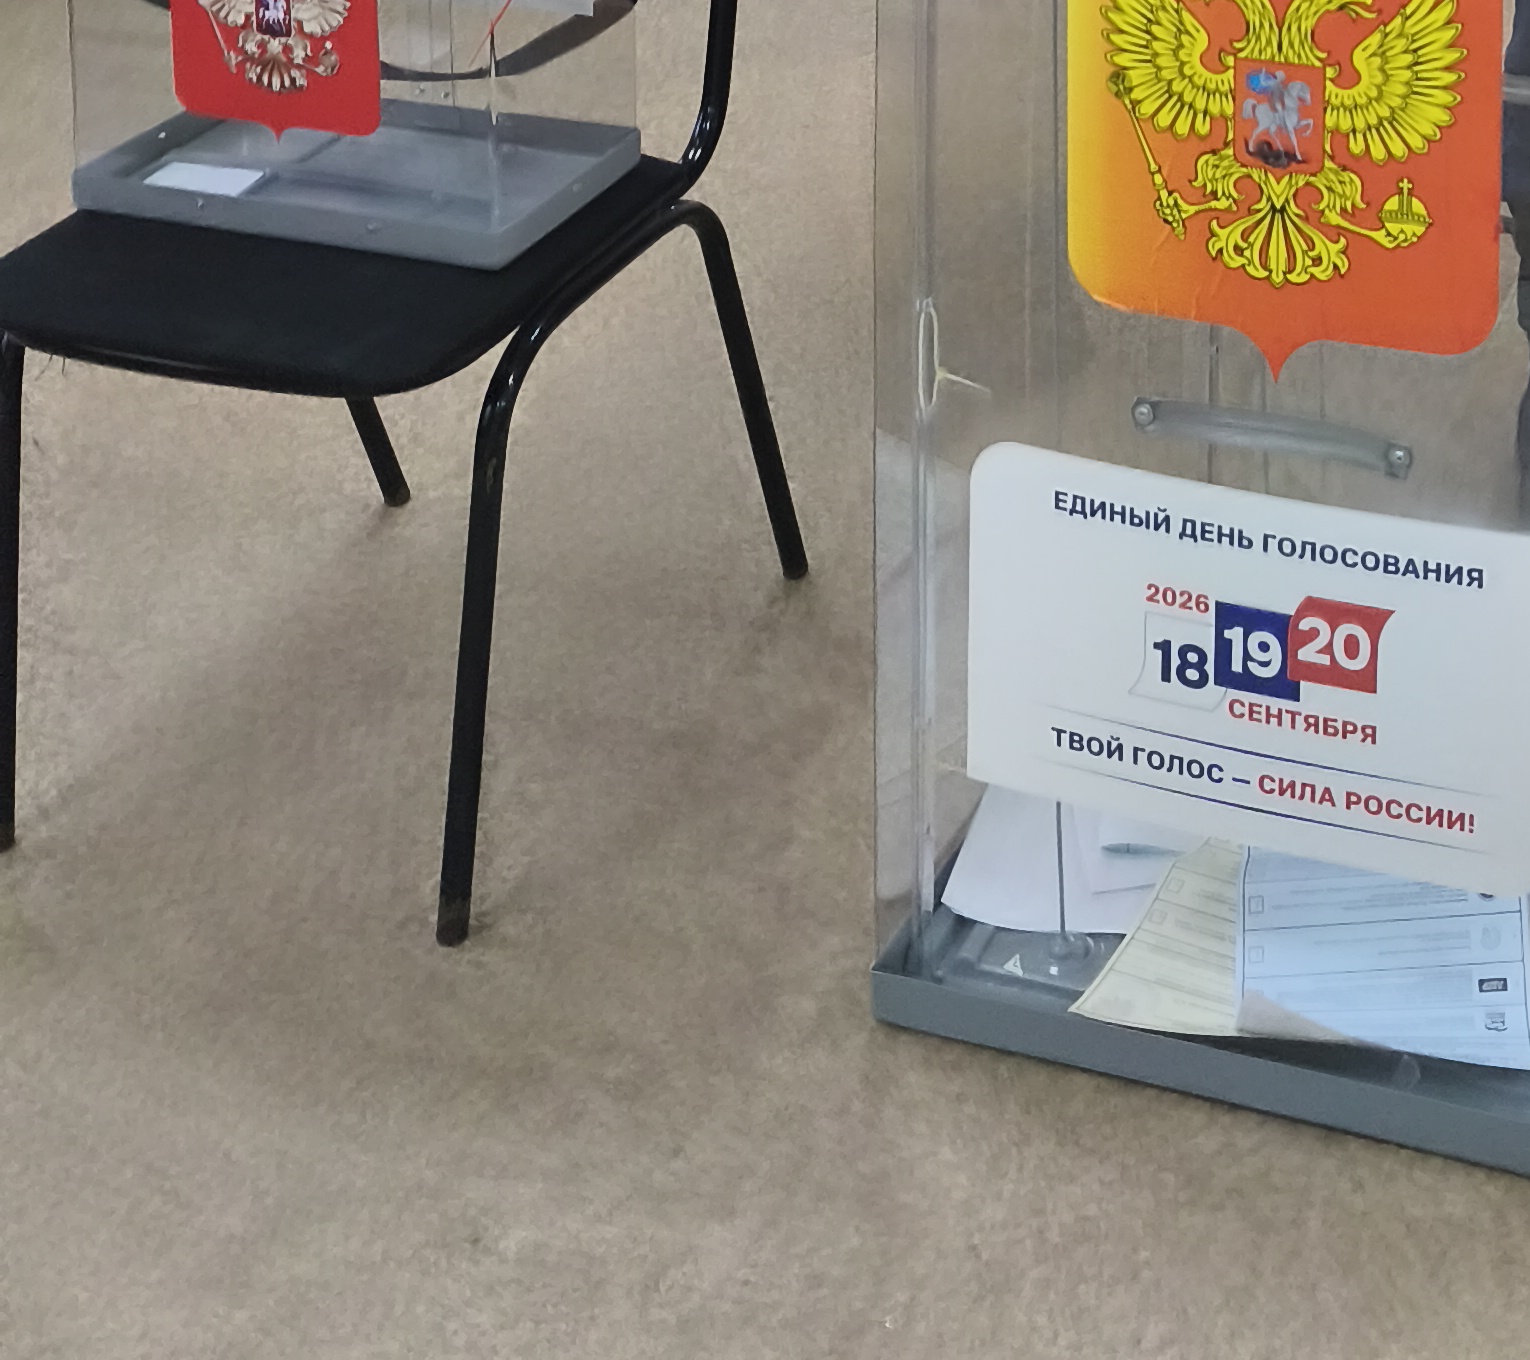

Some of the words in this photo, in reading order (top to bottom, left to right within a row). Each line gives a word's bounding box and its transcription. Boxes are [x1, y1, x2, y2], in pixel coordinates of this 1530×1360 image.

[1053, 489, 1172, 535] ЕДИНЫЙ
[1177, 517, 1255, 551] ДЕНЬ
[1261, 532, 1485, 590] ГОЛОСОВАНИЯ
[1144, 582, 1211, 614] 2026
[1152, 638, 1211, 690] 18
[1223, 625, 1283, 679] 19
[1297, 616, 1372, 672] 20
[1227, 697, 1378, 746] СЕНТЯБРЯ
[1050, 725, 1125, 763] ТВОЙ
[1131, 745, 1225, 784] ГОЛОС
[1257, 773, 1337, 808] СИЛА
[1344, 790, 1476, 834] РОССИИ!
